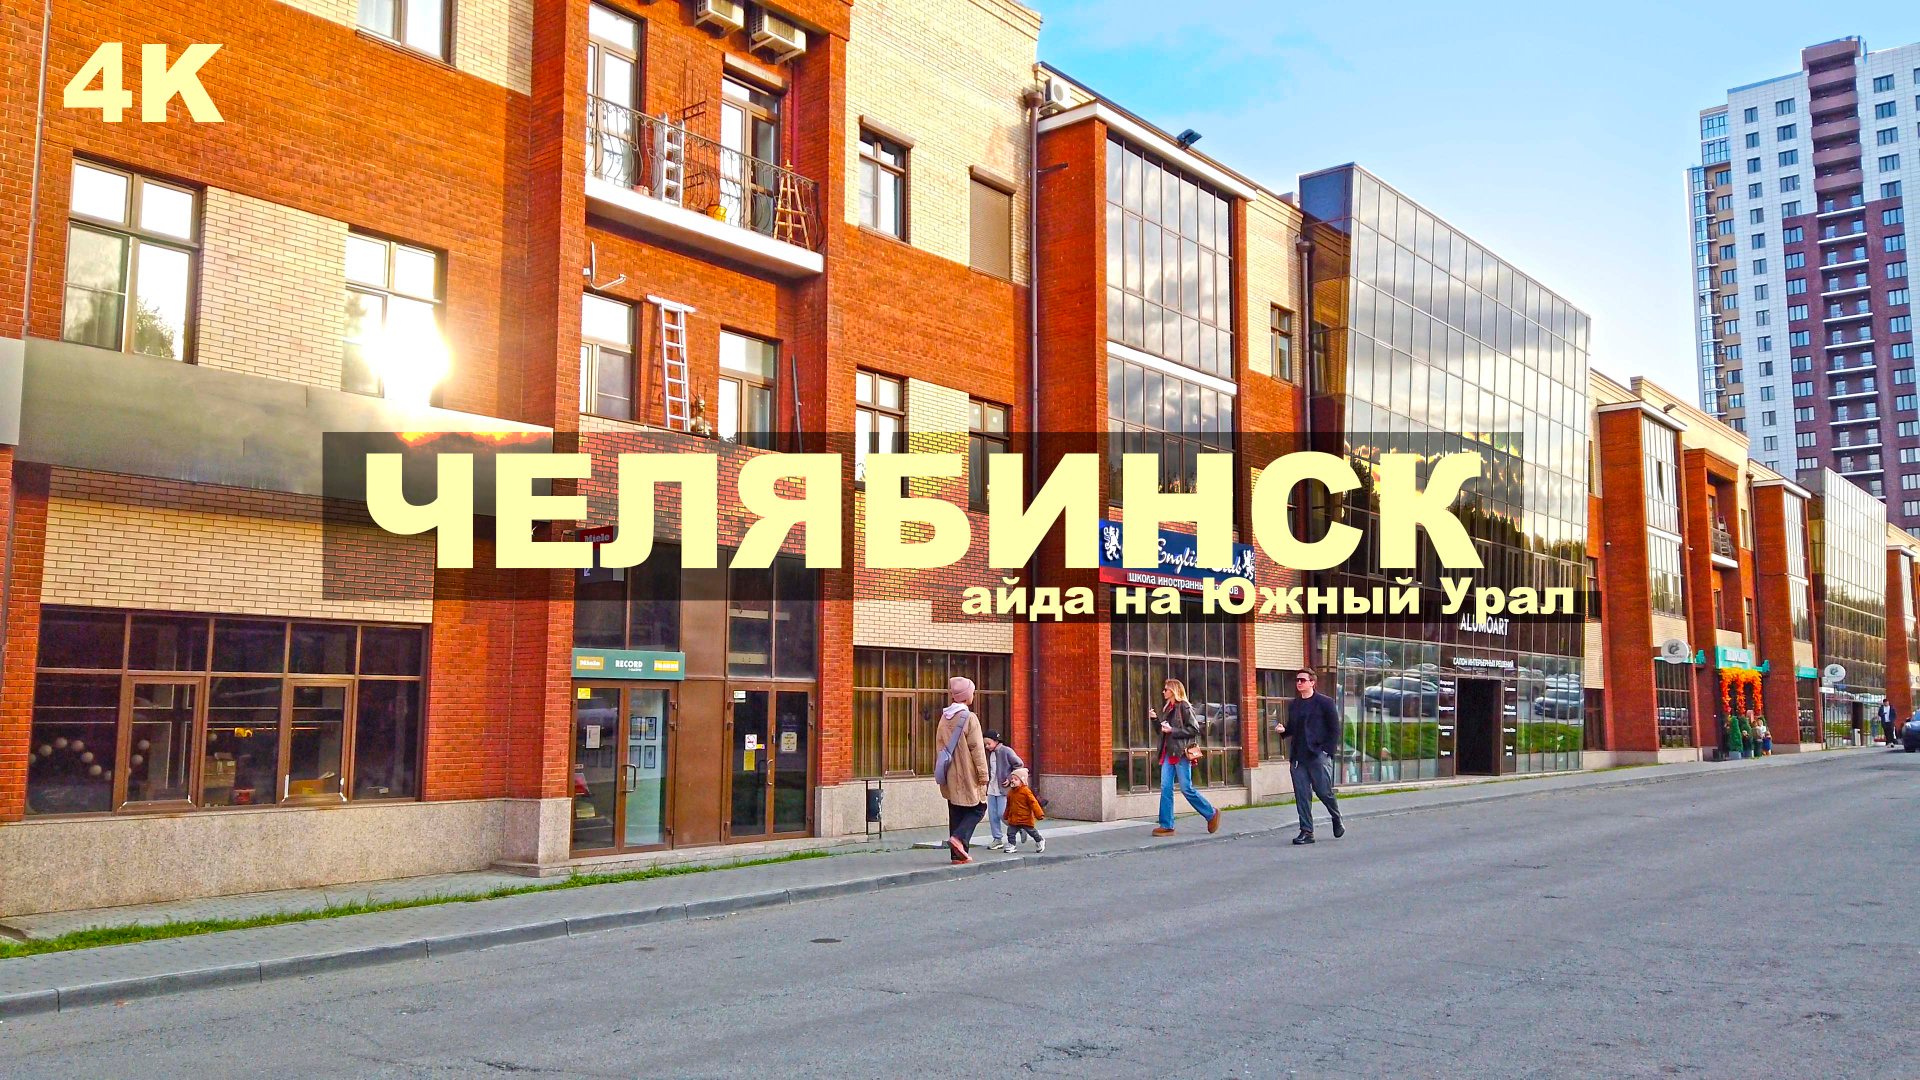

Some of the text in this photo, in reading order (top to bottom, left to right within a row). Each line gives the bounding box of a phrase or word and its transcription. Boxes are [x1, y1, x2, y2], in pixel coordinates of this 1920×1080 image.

[584, 533, 610, 543] Miele
[1158, 576, 1203, 590] иностранны
[615, 660, 643, 668] RECORD
